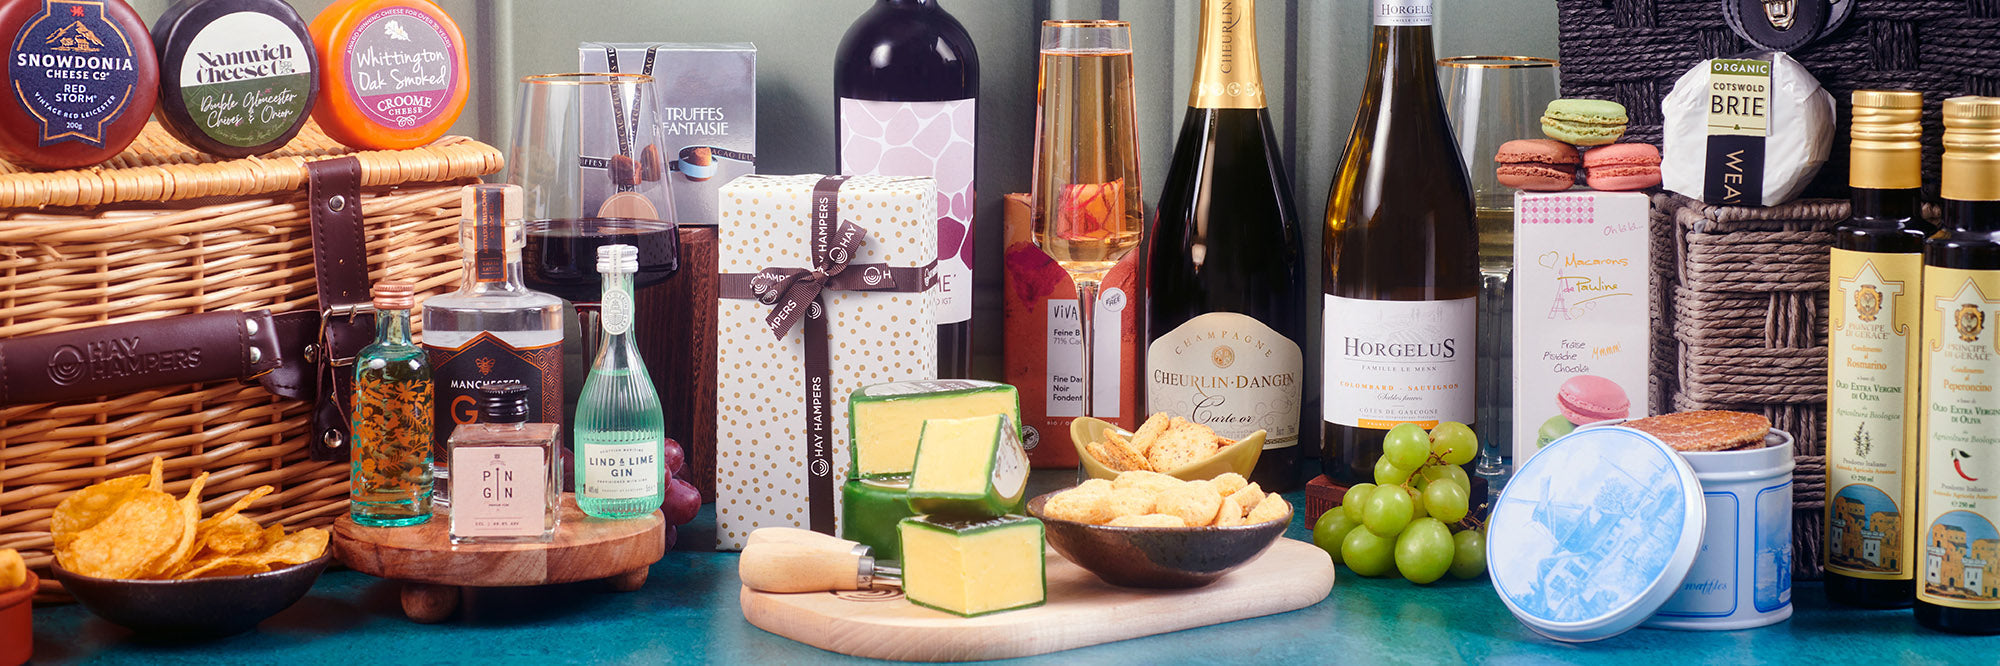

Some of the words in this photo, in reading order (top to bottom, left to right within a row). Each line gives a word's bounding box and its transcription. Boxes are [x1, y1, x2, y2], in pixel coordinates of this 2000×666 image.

[346, 32, 360, 54] AWARD
[359, 13, 382, 34] WINNING
[381, 8, 405, 17] CHEESE
[405, 8, 418, 16] FOR
[418, 12, 434, 27] OVER
[439, 28, 453, 48] YEARS
[17, 53, 133, 71] SNOWDONIA
[197, 44, 292, 68] Nantwich
[356, 45, 445, 73] Whittington
[46, 69, 89, 80] CHEESE
[196, 64, 268, 84] Cheese
[1713, 62, 1768, 74] ORGANIC
[358, 69, 387, 91] Oak
[390, 65, 447, 90] Smoked
[64, 84, 87, 93] RED
[1713, 82, 1765, 92] COTSWOLD
[34, 91, 62, 116] VINTAGE
[81, 95, 116, 119] LEICESTER
[200, 93, 238, 112] Double
[243, 88, 297, 113] Gloucester
[377, 95, 432, 111] CROOME
[1711, 95, 1765, 116] BRIE
[207, 110, 242, 128] Chives
[261, 105, 293, 123] Onion
[388, 107, 423, 116] CHEESE
[665, 107, 724, 121] TRUFFES
[66, 122, 83, 130] 200g
[662, 122, 728, 135] FANTAISIE
[711, 149, 736, 159] ACAO
[1723, 150, 1745, 204] WEA
[818, 197, 829, 252] HAMPERS
[839, 224, 857, 248] HAY
[1565, 252, 1629, 269] Macarons
[1557, 276, 1618, 292] Pauline
[1563, 278, 1575, 293] de
[1849, 324, 1885, 332] PRINCIPE
[1053, 337, 1067, 345] 71%
[1175, 330, 1272, 358] CHAMPAGNE
[1561, 340, 1586, 349] Fraise
[88, 337, 139, 362] HAY
[1948, 344, 1988, 353] PRINCIPE
[1543, 352, 1578, 361] Pistache
[1846, 357, 1887, 370] Rosmarino
[91, 347, 201, 381] HAMPERS
[1362, 364, 1396, 372] FAMILLE
[1053, 375, 1068, 383] Fine
[1340, 380, 1394, 391] COLOMBARD
[1407, 383, 1459, 392] SAUVIGNON
[1944, 378, 1992, 392] Peperoncino
[1053, 384, 1069, 392] Noir
[1836, 379, 1849, 389] OLIO
[1851, 382, 1872, 392] EXTRA
[1874, 384, 1902, 394] VERGINE
[812, 376, 823, 431] HAMPERS
[1859, 392, 1880, 401] OLIVA
[1192, 393, 1236, 425] Carte
[1836, 408, 1868, 419] Agricoltura
[1869, 411, 1900, 421] Biologica
[1932, 402, 1948, 412] OLIO
[1951, 404, 1973, 415] EXTRA
[1960, 414, 1981, 425] OLIVA
[814, 434, 824, 457] HAY
[589, 456, 616, 467] LIND
[629, 454, 654, 466] LIME
[610, 468, 633, 478] GIN
